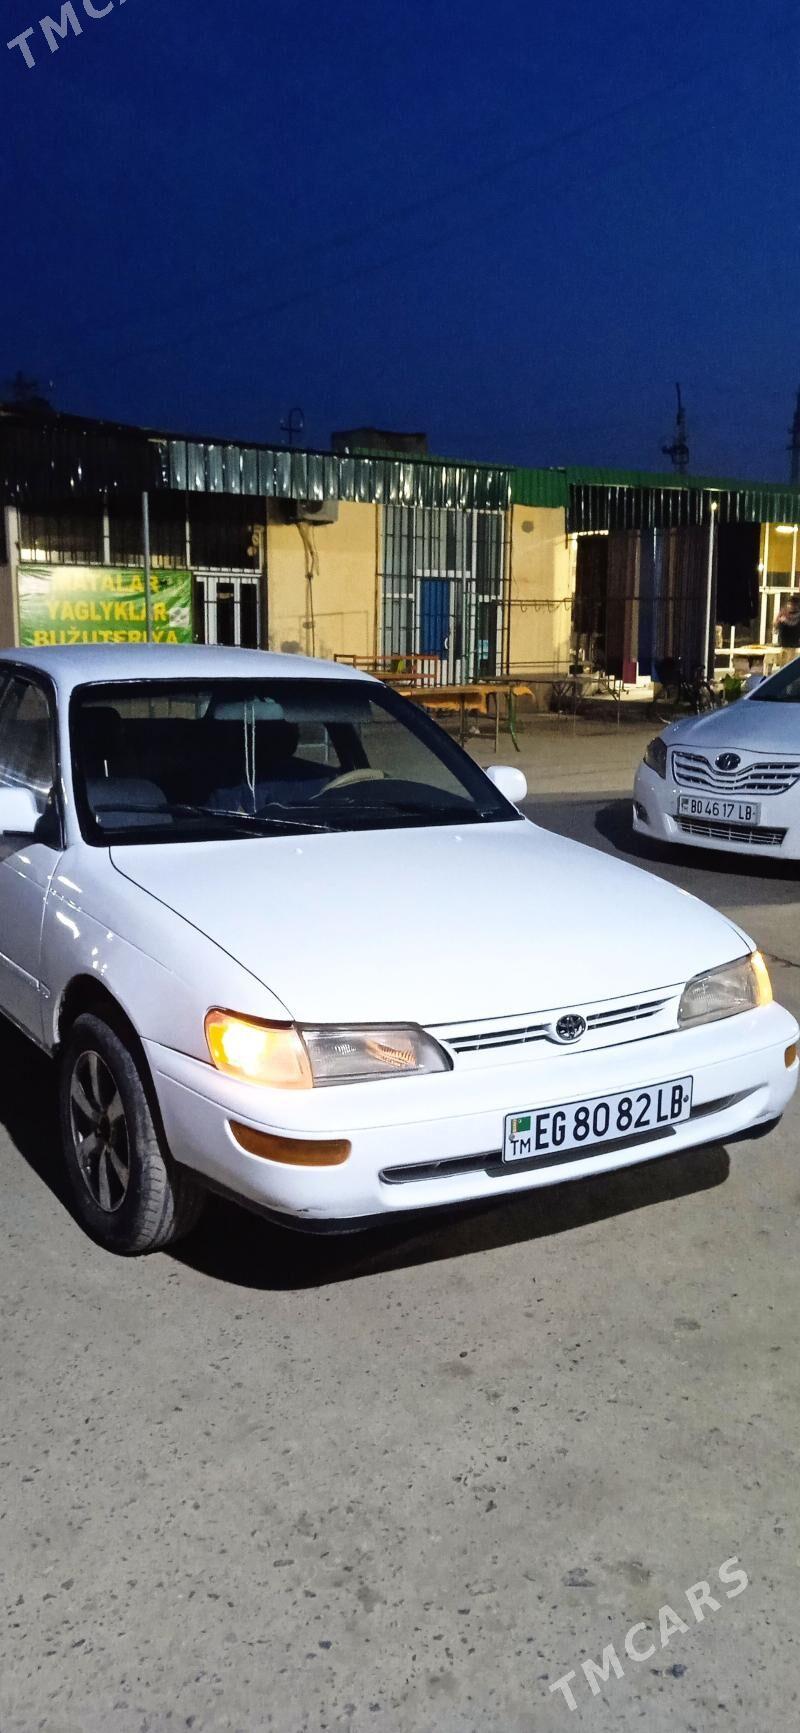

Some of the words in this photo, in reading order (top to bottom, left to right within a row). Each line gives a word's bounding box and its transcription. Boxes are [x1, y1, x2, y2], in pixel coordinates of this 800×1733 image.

[52, 574, 161, 593] ATALAR
[705, 802, 719, 816] 46
[723, 803, 735, 818] 17
[738, 805, 752, 820] LB
[535, 1111, 566, 1150] EG
[573, 1102, 610, 1142] 80
[616, 1092, 650, 1132] 82
[657, 1084, 683, 1122] LB
[511, 1137, 531, 1155] TM
